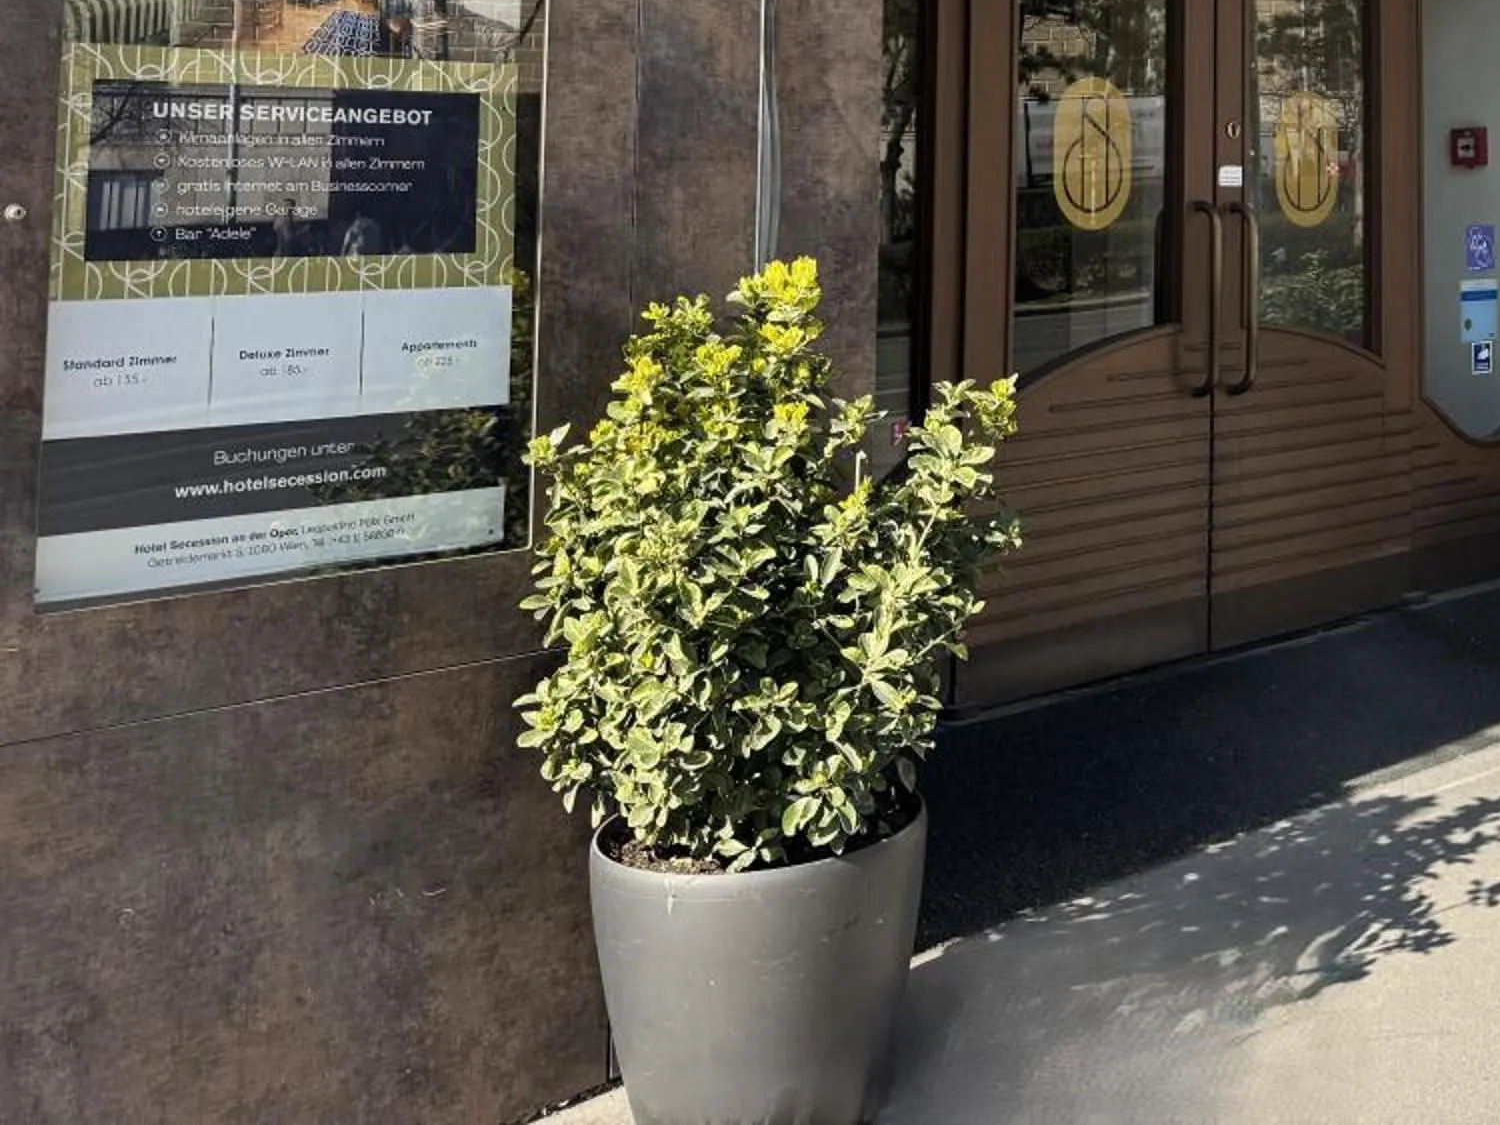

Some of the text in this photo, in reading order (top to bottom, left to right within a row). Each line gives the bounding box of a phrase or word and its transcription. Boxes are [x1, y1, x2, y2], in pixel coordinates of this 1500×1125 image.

[153, 102, 433, 126] UNSER SERVICEANGEBOT
[327, 134, 385, 147] Zimmern
[267, 155, 318, 169] W-LAN
[369, 157, 425, 170] Zimmern
[177, 180, 221, 196] gratis
[286, 182, 309, 192] am
[175, 228, 203, 241] Bar
[239, 348, 330, 360] Deluxe Zimmer
[63, 355, 177, 371] Standard Zimmer
[213, 442, 355, 466] Buchungen unter
[174, 465, 387, 499] www.hotelsecession.com
[134, 542, 167, 555] Hotel
[169, 535, 229, 550] Secession
